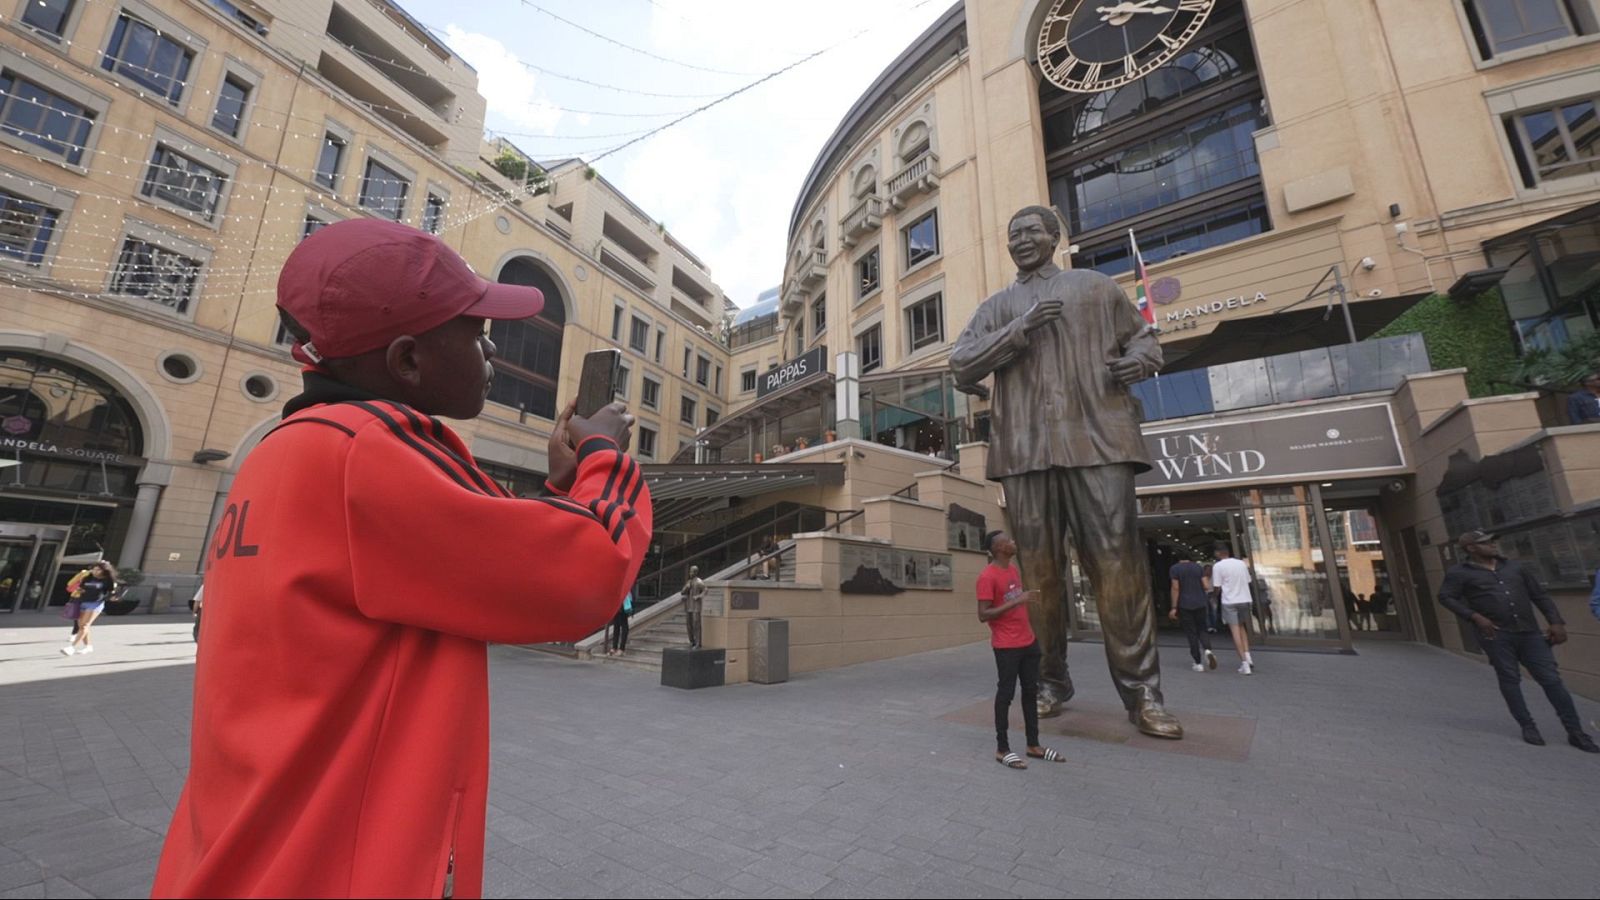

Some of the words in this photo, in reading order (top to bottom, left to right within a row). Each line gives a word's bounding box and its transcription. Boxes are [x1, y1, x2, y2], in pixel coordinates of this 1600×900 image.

[1166, 291, 1267, 322] MANDELA
[766, 359, 807, 390] PAPPAS
[0, 438, 58, 453] NDELA
[65, 447, 124, 463] SQUARE
[1157, 433, 1209, 458] UN
[1318, 439, 1353, 447] MANDELA
[1155, 449, 1266, 480] WIND
[208, 500, 259, 570] OL
